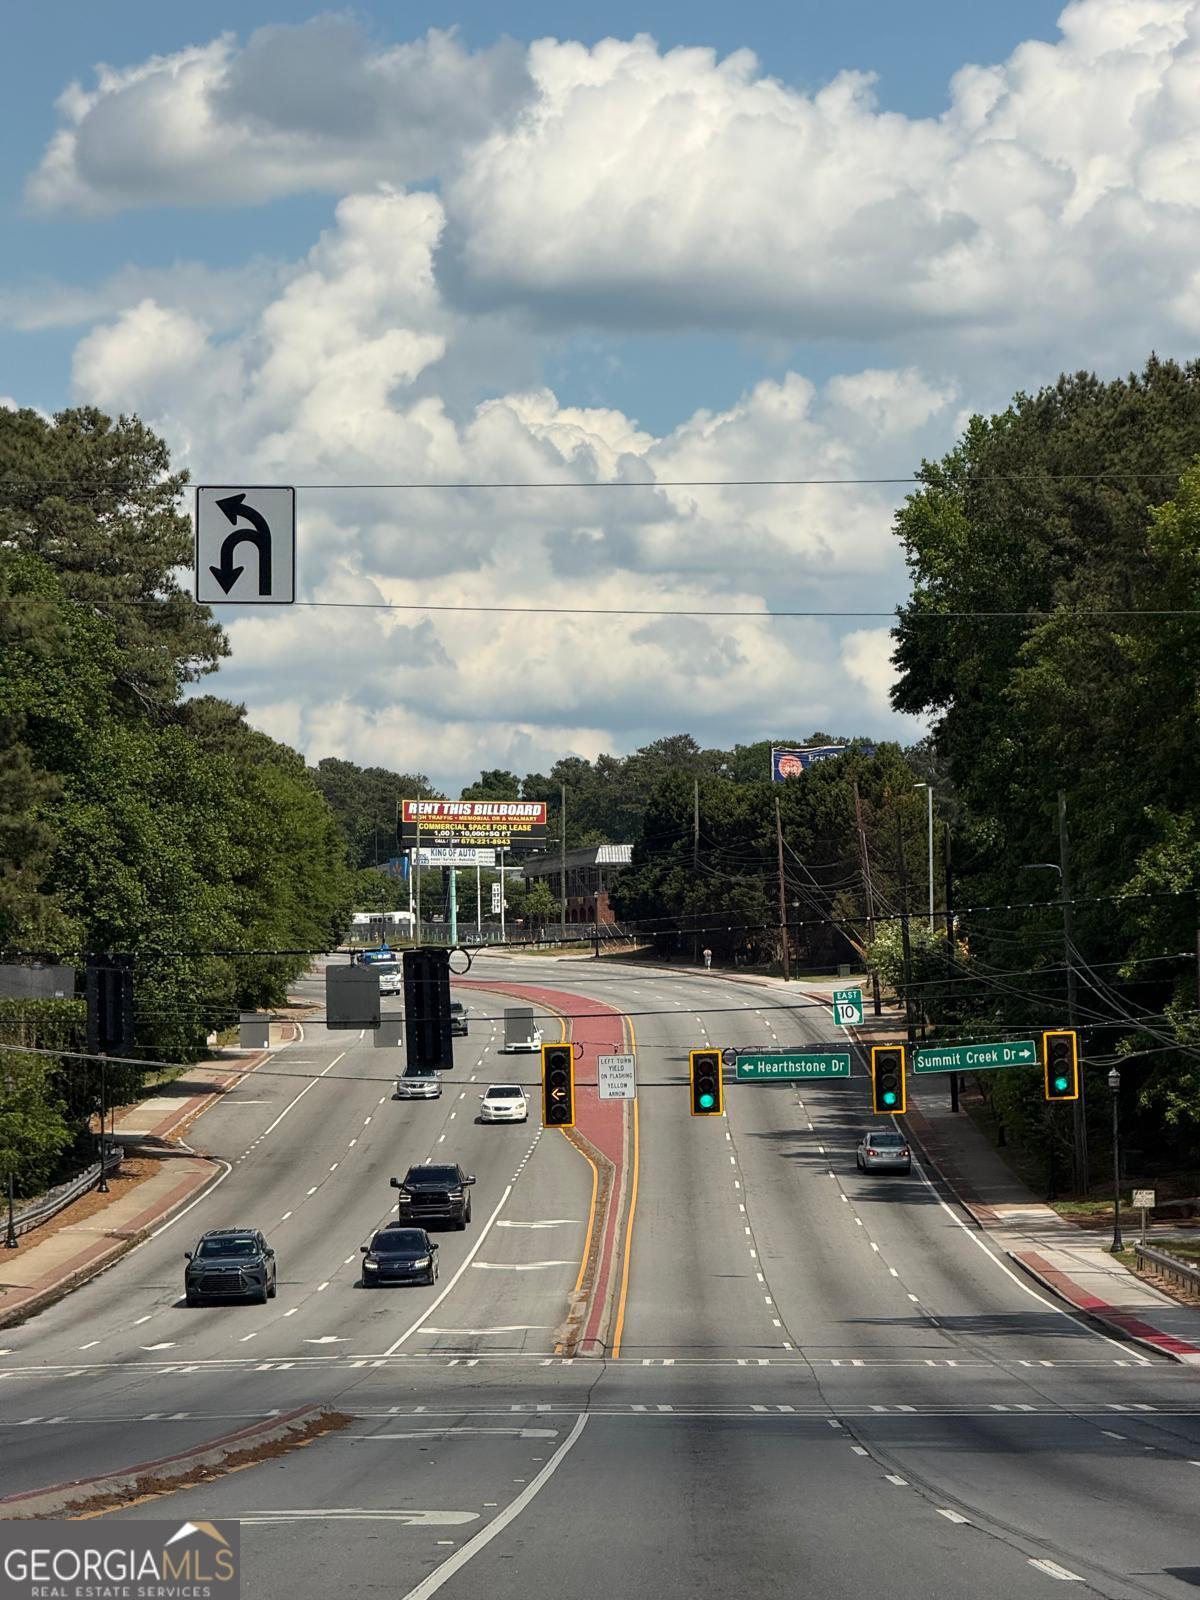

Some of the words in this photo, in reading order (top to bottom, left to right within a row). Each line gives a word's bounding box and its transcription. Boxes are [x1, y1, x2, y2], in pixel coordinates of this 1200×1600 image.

[408, 802, 440, 814] RENT
[443, 803, 472, 815] THIS
[473, 804, 542, 816] BILLBOARD
[418, 822, 467, 830] COMMERCIAL
[468, 823, 491, 831] SPACE
[430, 848, 447, 857] KING
[448, 849, 457, 857] OF
[458, 849, 477, 858] AUTO
[836, 991, 858, 1000] EAST
[840, 1005, 855, 1019] 10
[917, 1053, 961, 1068] Summit
[966, 1049, 998, 1064] Creek
[1003, 1048, 1017, 1061] Dr
[757, 1060, 826, 1073] Hearthstone
[831, 1059, 845, 1071] Dr
